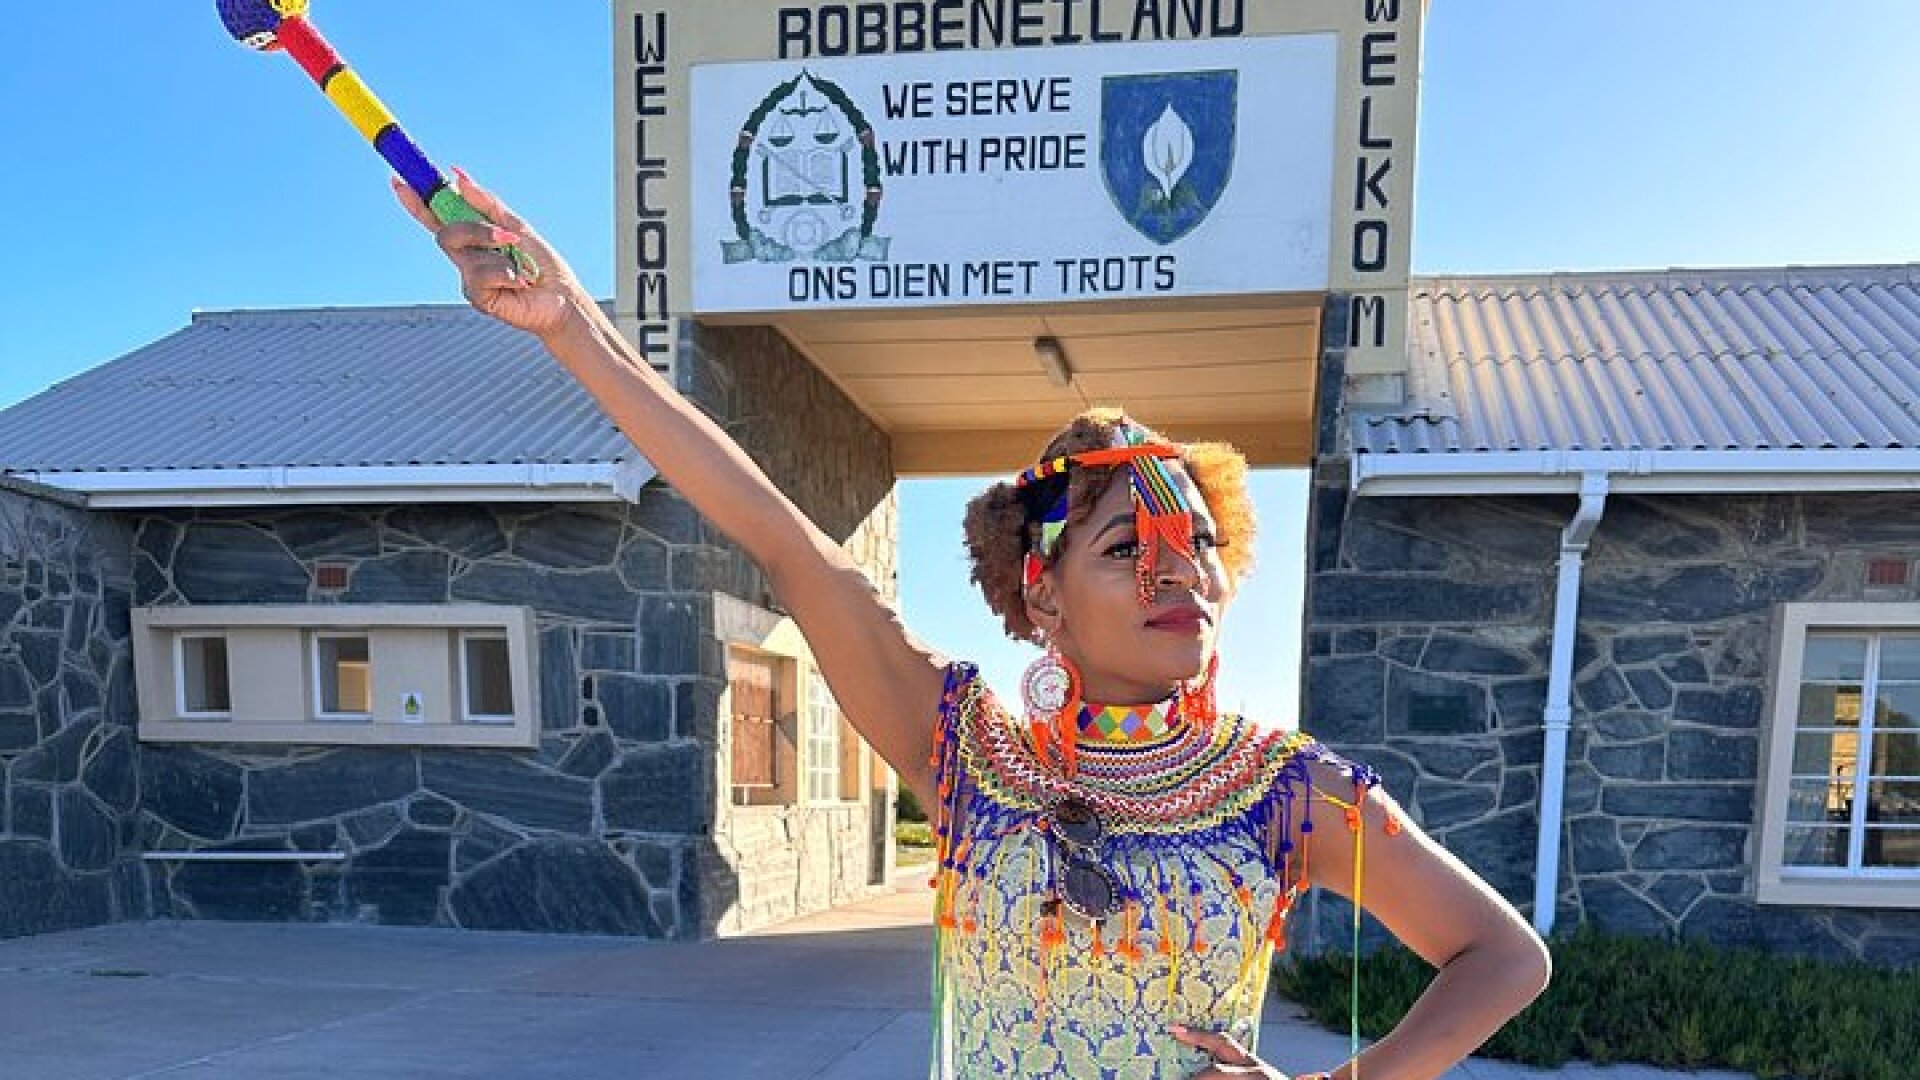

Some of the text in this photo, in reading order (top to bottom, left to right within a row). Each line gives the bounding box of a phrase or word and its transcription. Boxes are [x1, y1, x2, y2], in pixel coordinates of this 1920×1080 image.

[779, 0, 1243, 59] ROBBENEILAND
[882, 77, 1071, 119] WE SERVE
[882, 133, 1086, 176] WITH PRIDE
[634, 12, 669, 372] WELCOME
[789, 255, 1176, 301] ONS DIEN MET TROTS
